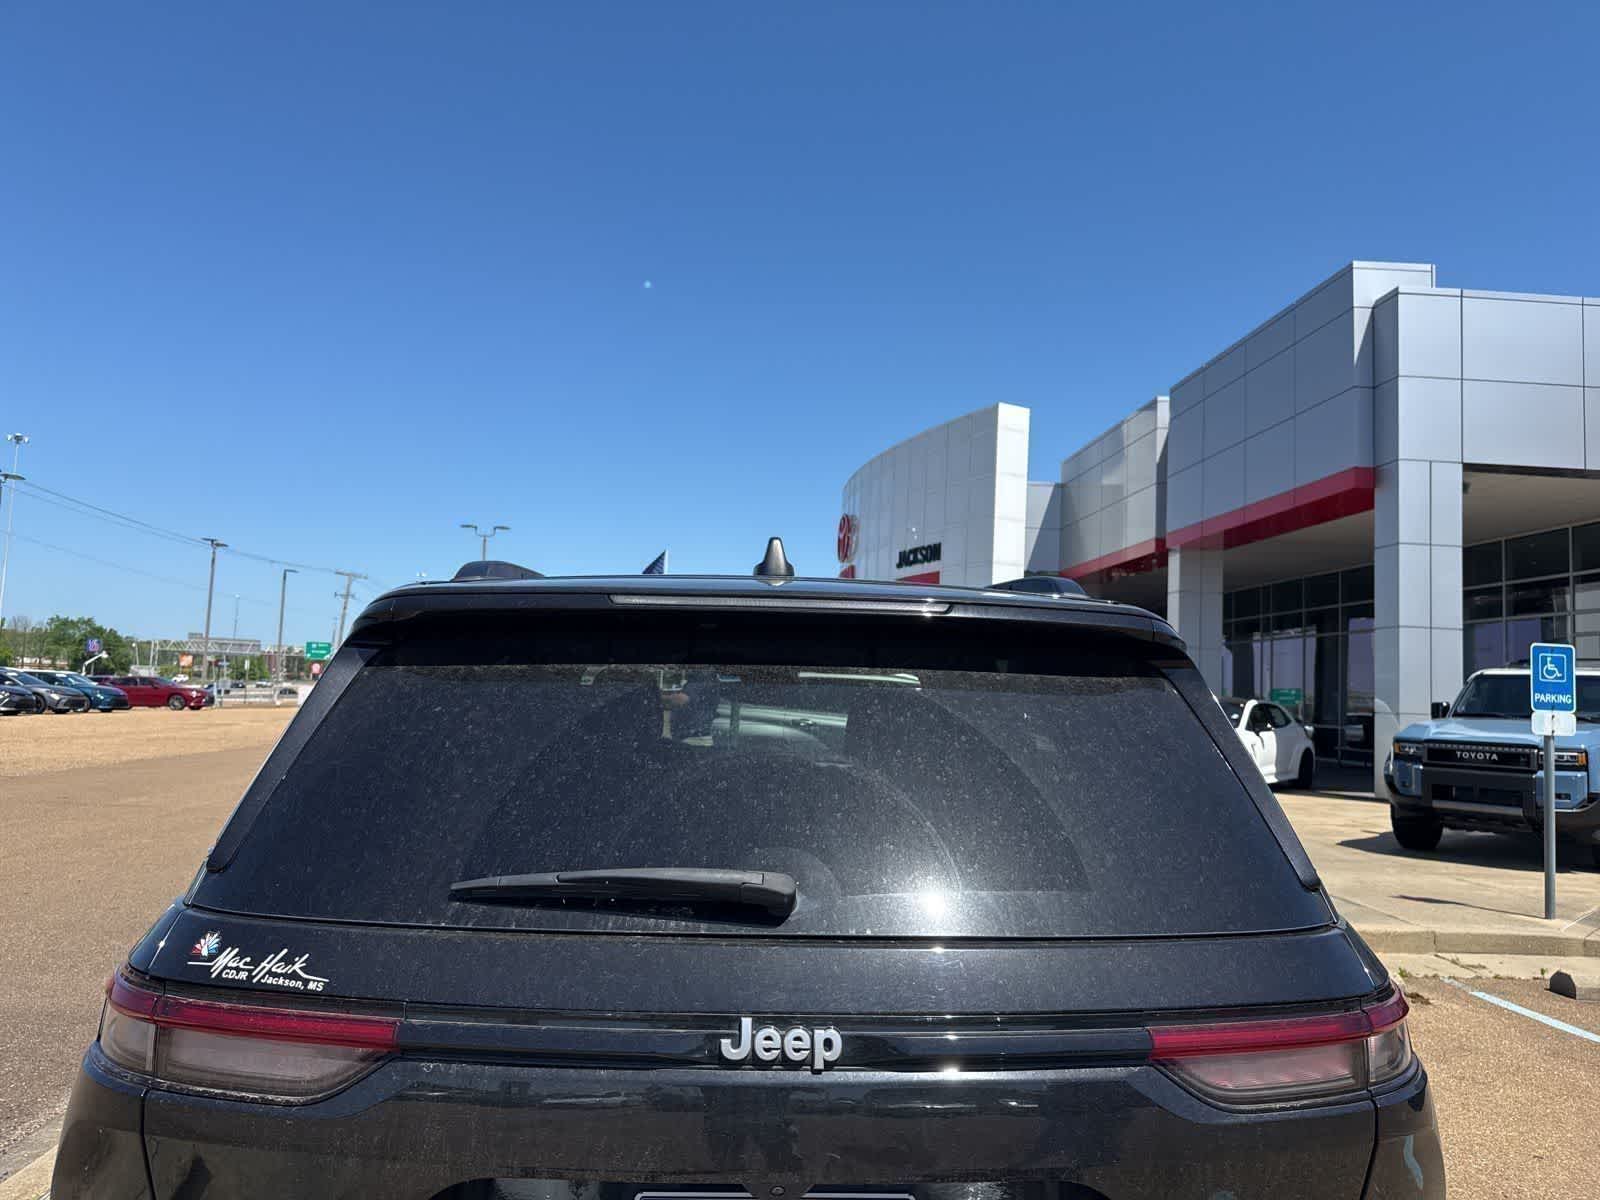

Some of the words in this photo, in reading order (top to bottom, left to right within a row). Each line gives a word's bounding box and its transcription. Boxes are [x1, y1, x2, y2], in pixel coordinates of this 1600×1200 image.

[896, 542, 942, 569] JACKSON
[1534, 692, 1572, 705] PARKING
[1456, 751, 1498, 761] TOYOTA
[210, 946, 254, 979] Mac
[222, 969, 248, 981] CDJR
[260, 974, 305, 990] Jackson,
[307, 981, 325, 992] MS
[720, 1016, 843, 1071] Jeep
